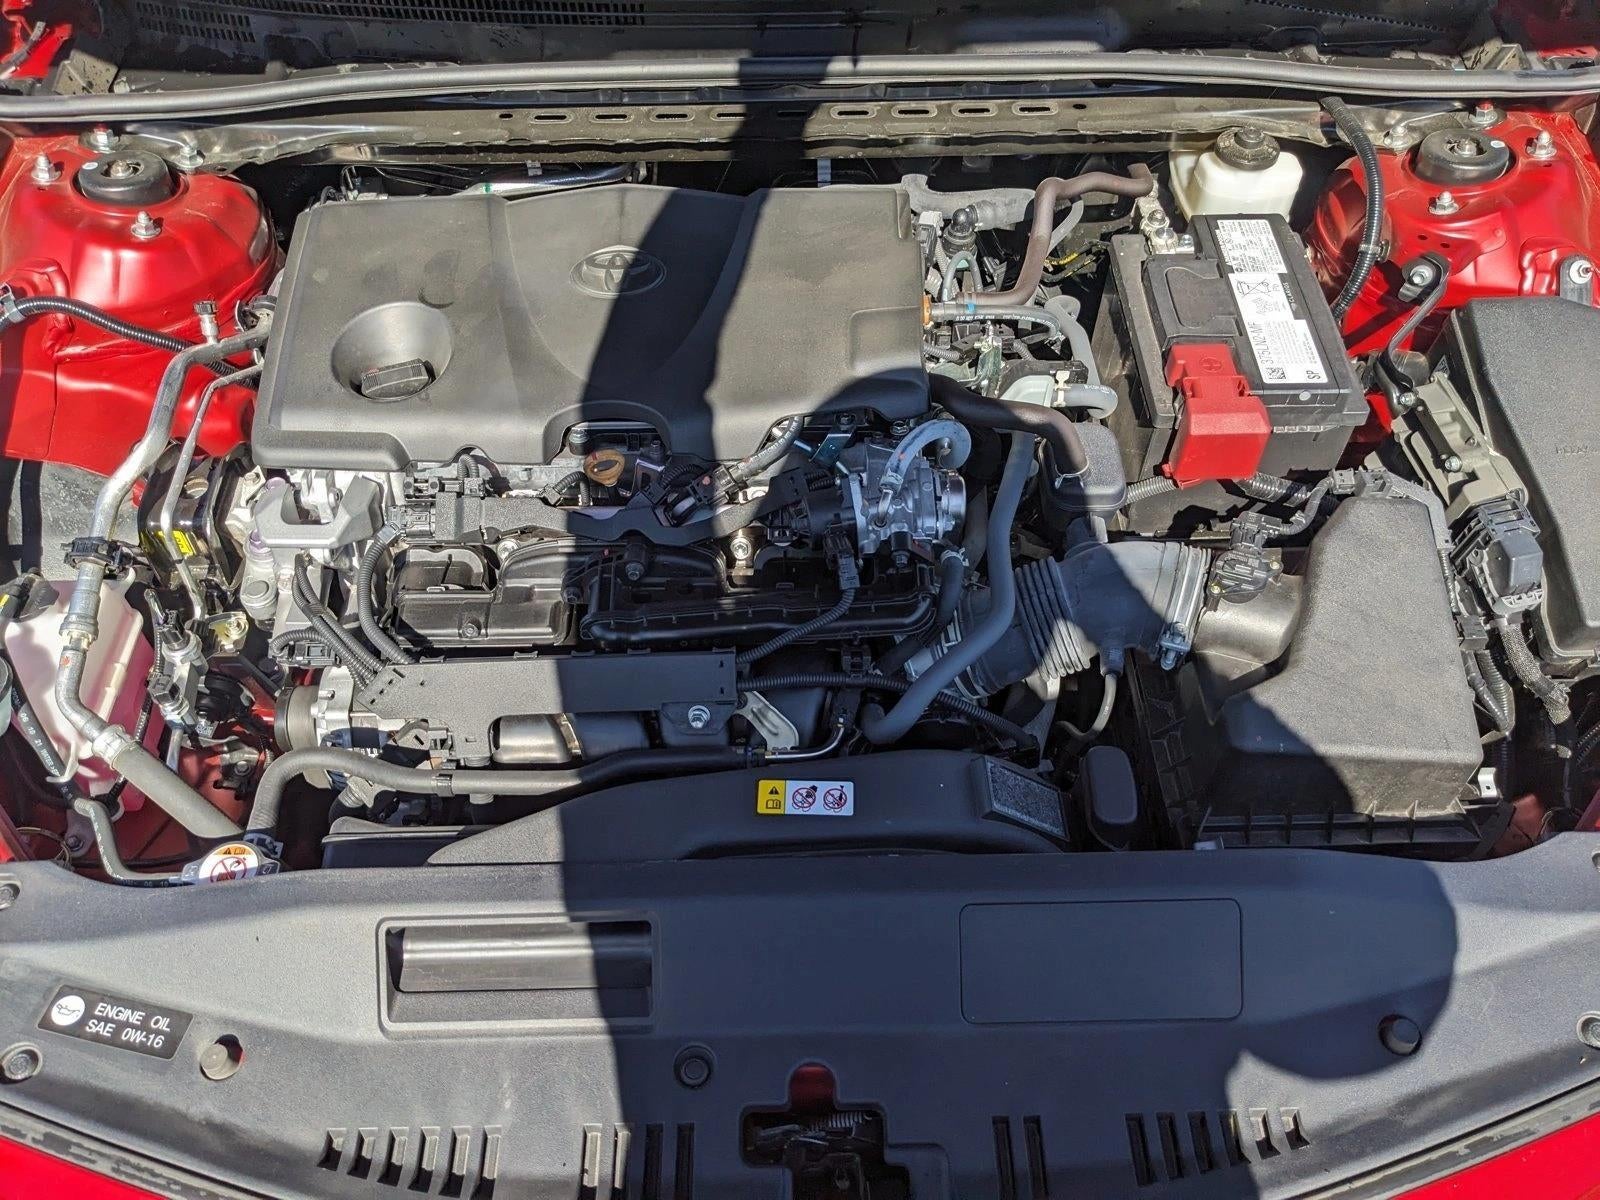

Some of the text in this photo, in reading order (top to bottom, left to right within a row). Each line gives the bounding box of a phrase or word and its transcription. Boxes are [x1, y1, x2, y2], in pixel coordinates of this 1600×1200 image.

[1247, 321, 1275, 365] 375LN2-MF
[1306, 370, 1321, 380] SP
[94, 1002, 171, 1032] ENGINE OIL
[86, 1019, 165, 1048] SAE 0W-16
